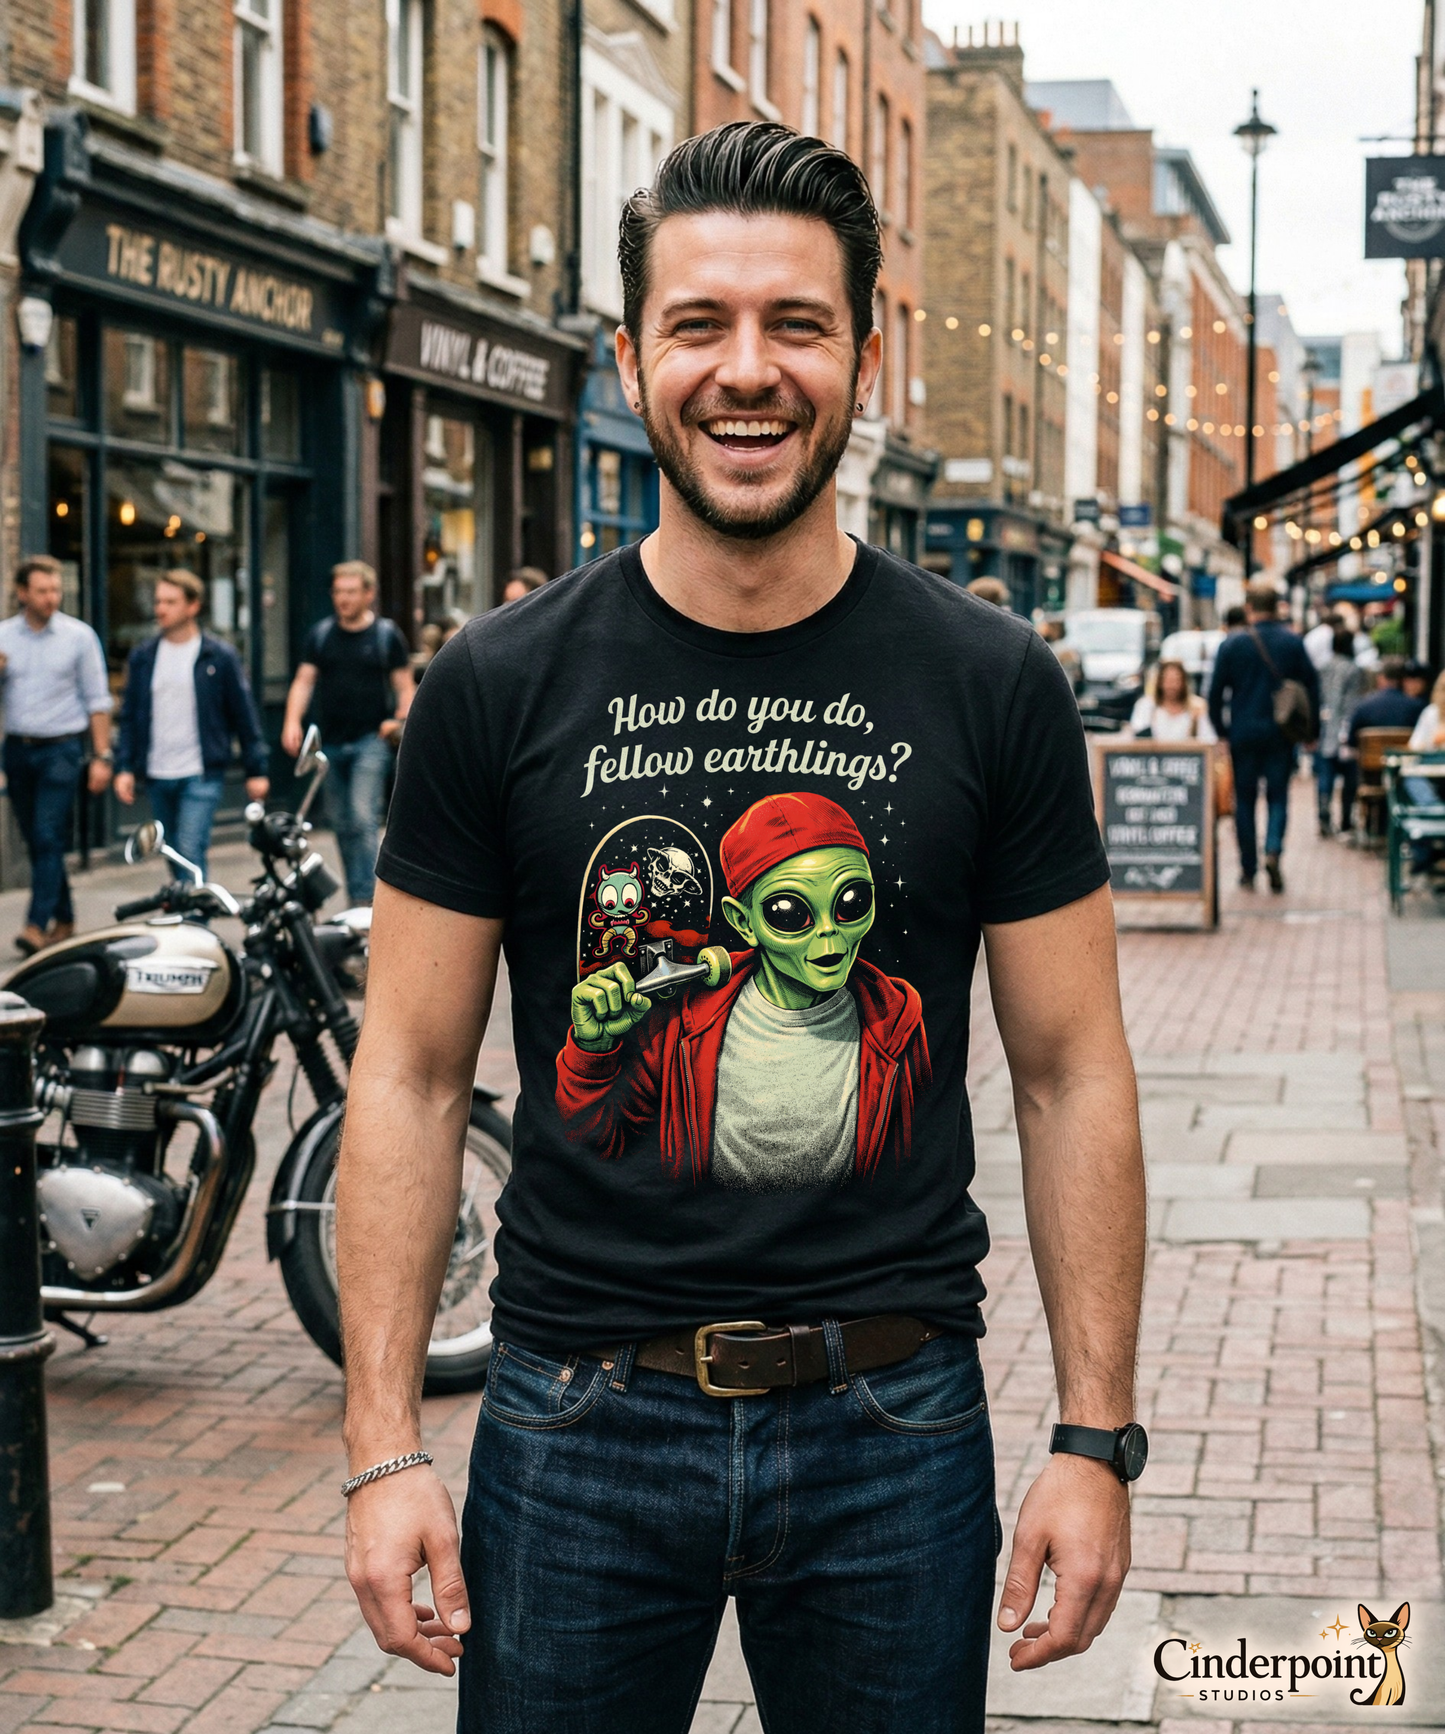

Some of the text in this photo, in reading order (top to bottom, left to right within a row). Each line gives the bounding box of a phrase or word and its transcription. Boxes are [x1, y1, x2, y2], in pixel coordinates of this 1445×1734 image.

[106, 223, 314, 332] THE RUSTY ANCHOR
[420, 319, 550, 401] VINYL & COFFEE
[607, 688, 874, 736] How do you do,
[579, 737, 913, 799] fellow earthlings?
[137, 971, 202, 985] TRIUMPH
